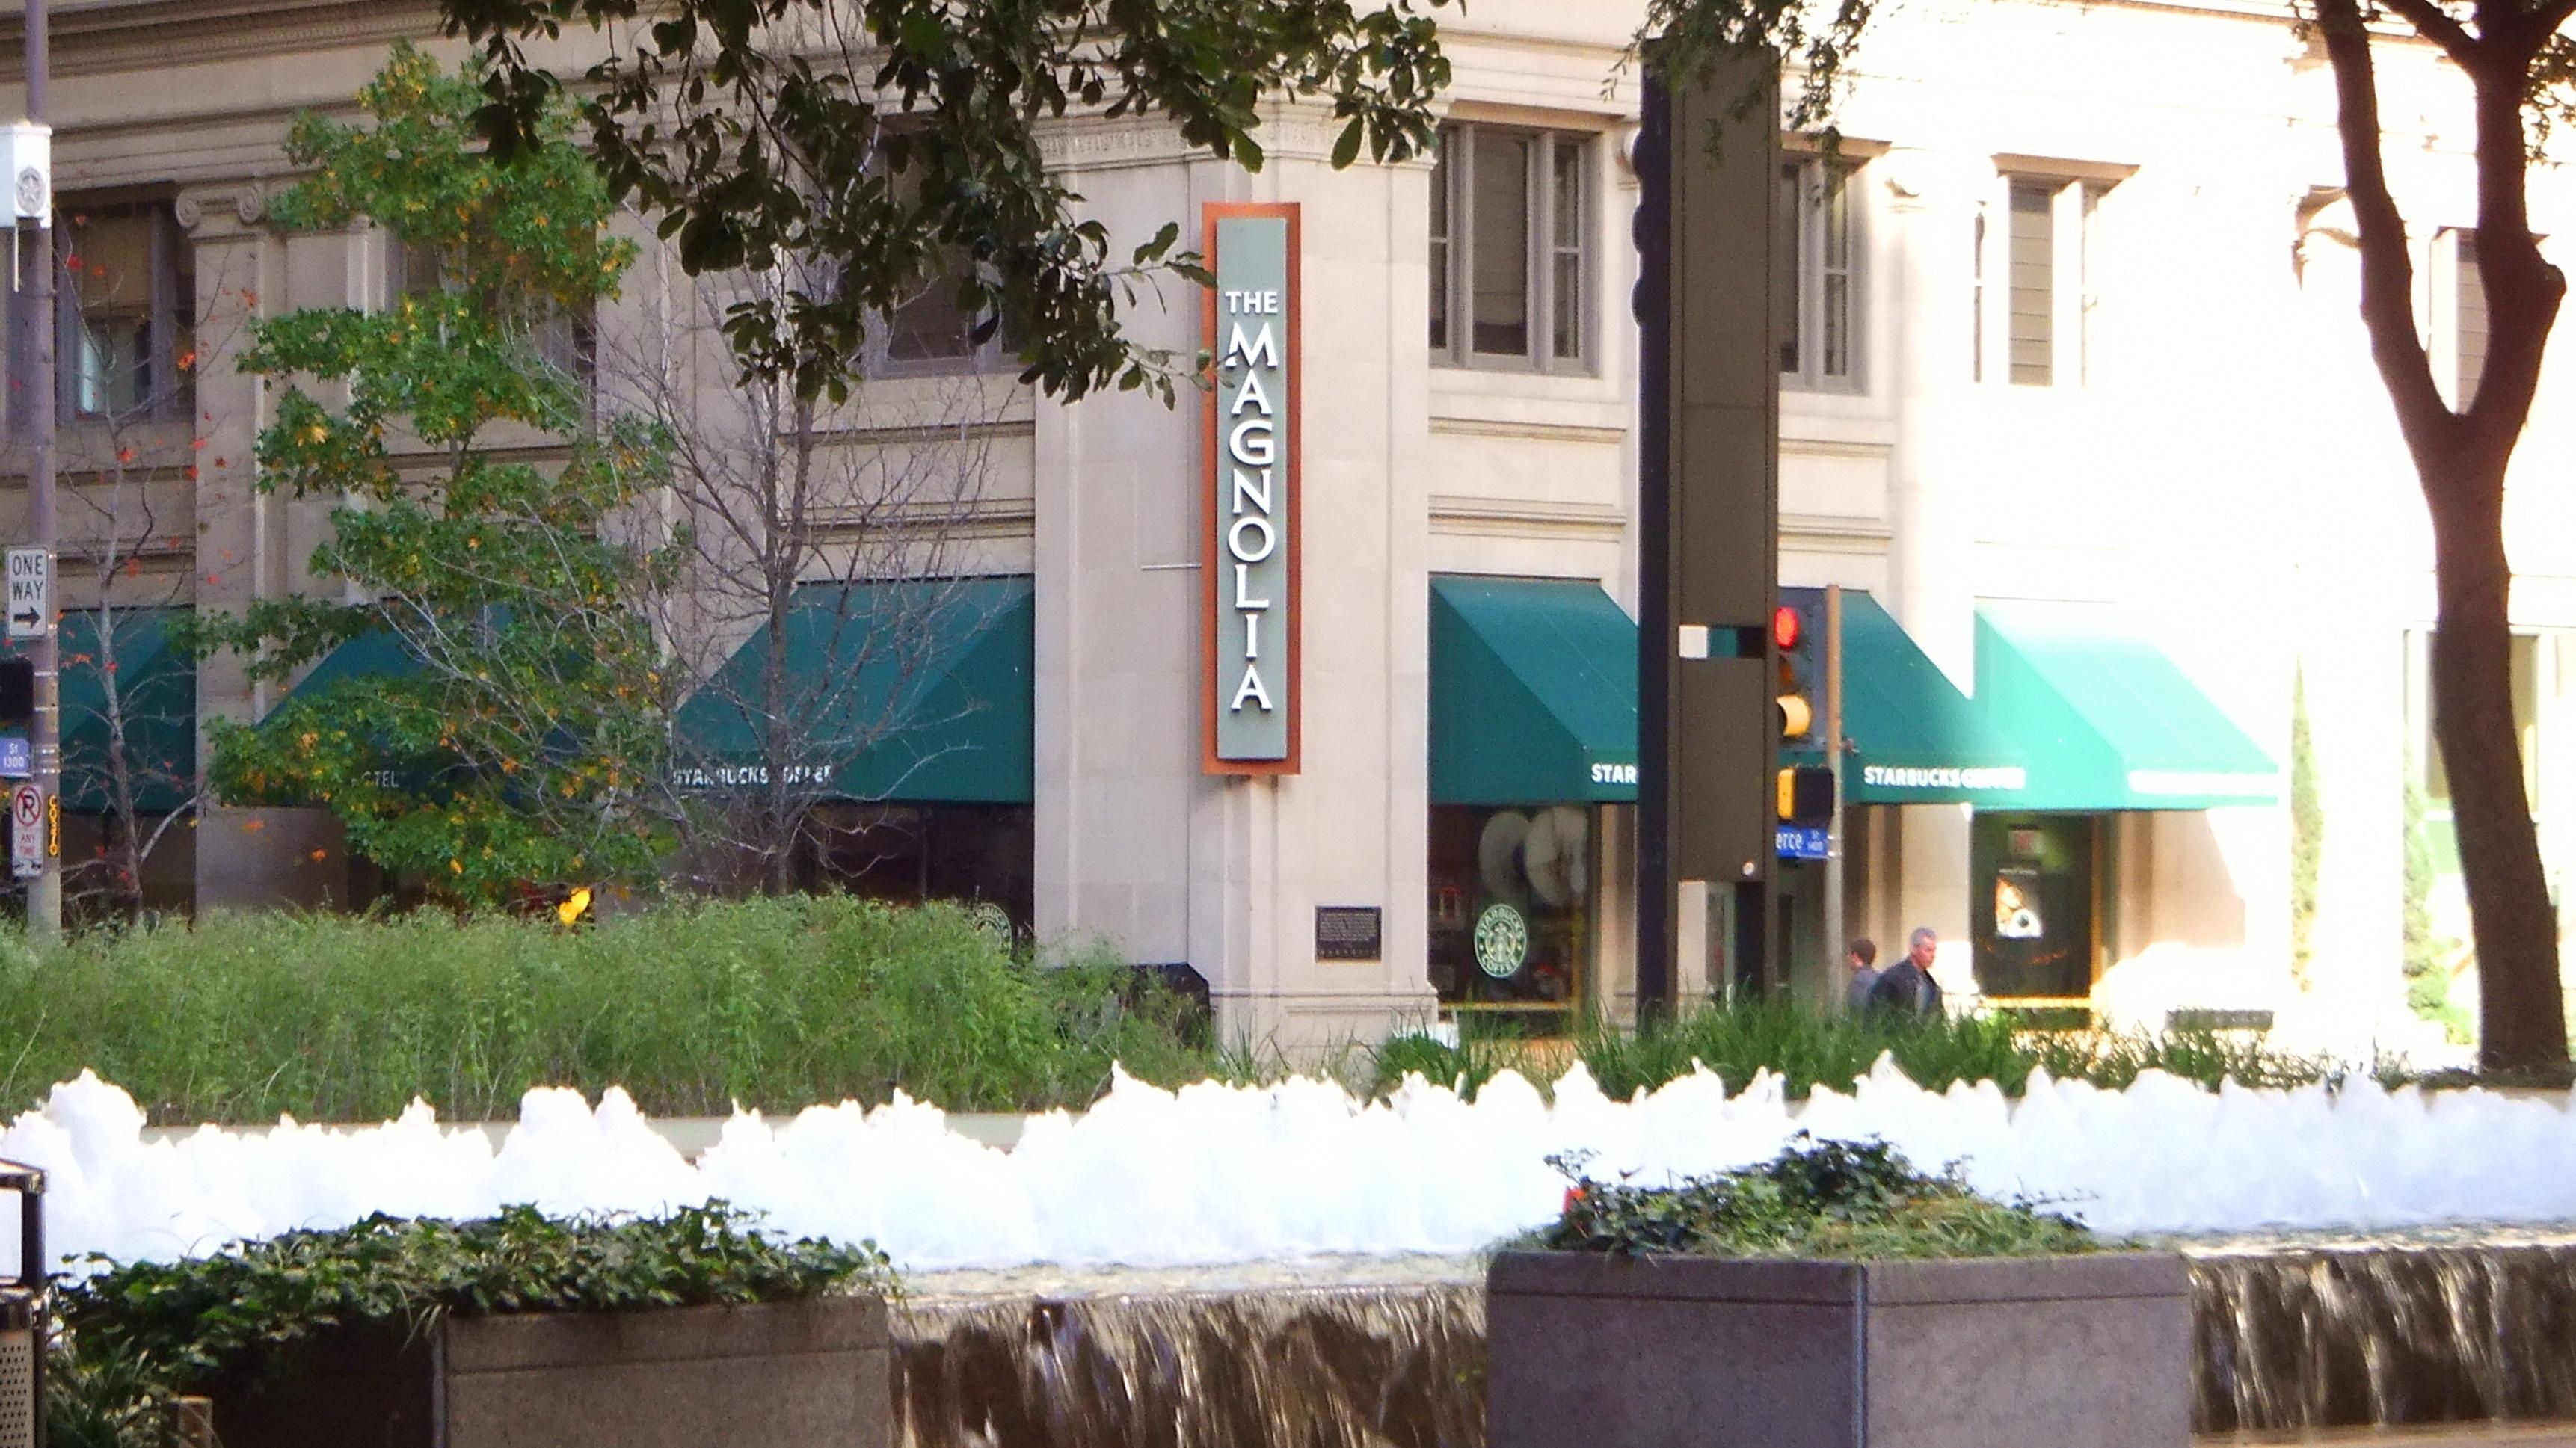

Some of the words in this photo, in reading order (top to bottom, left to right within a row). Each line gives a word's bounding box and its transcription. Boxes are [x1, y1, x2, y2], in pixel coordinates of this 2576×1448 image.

[1225, 291, 1279, 315] THE
[1224, 321, 1279, 711] MAGNOLIA
[13, 555, 43, 576] ONE
[13, 580, 43, 600] WAY
[1591, 762, 1638, 784] STAR
[1863, 766, 1961, 788] STARBUCKS
[1776, 833, 1802, 850] erce
